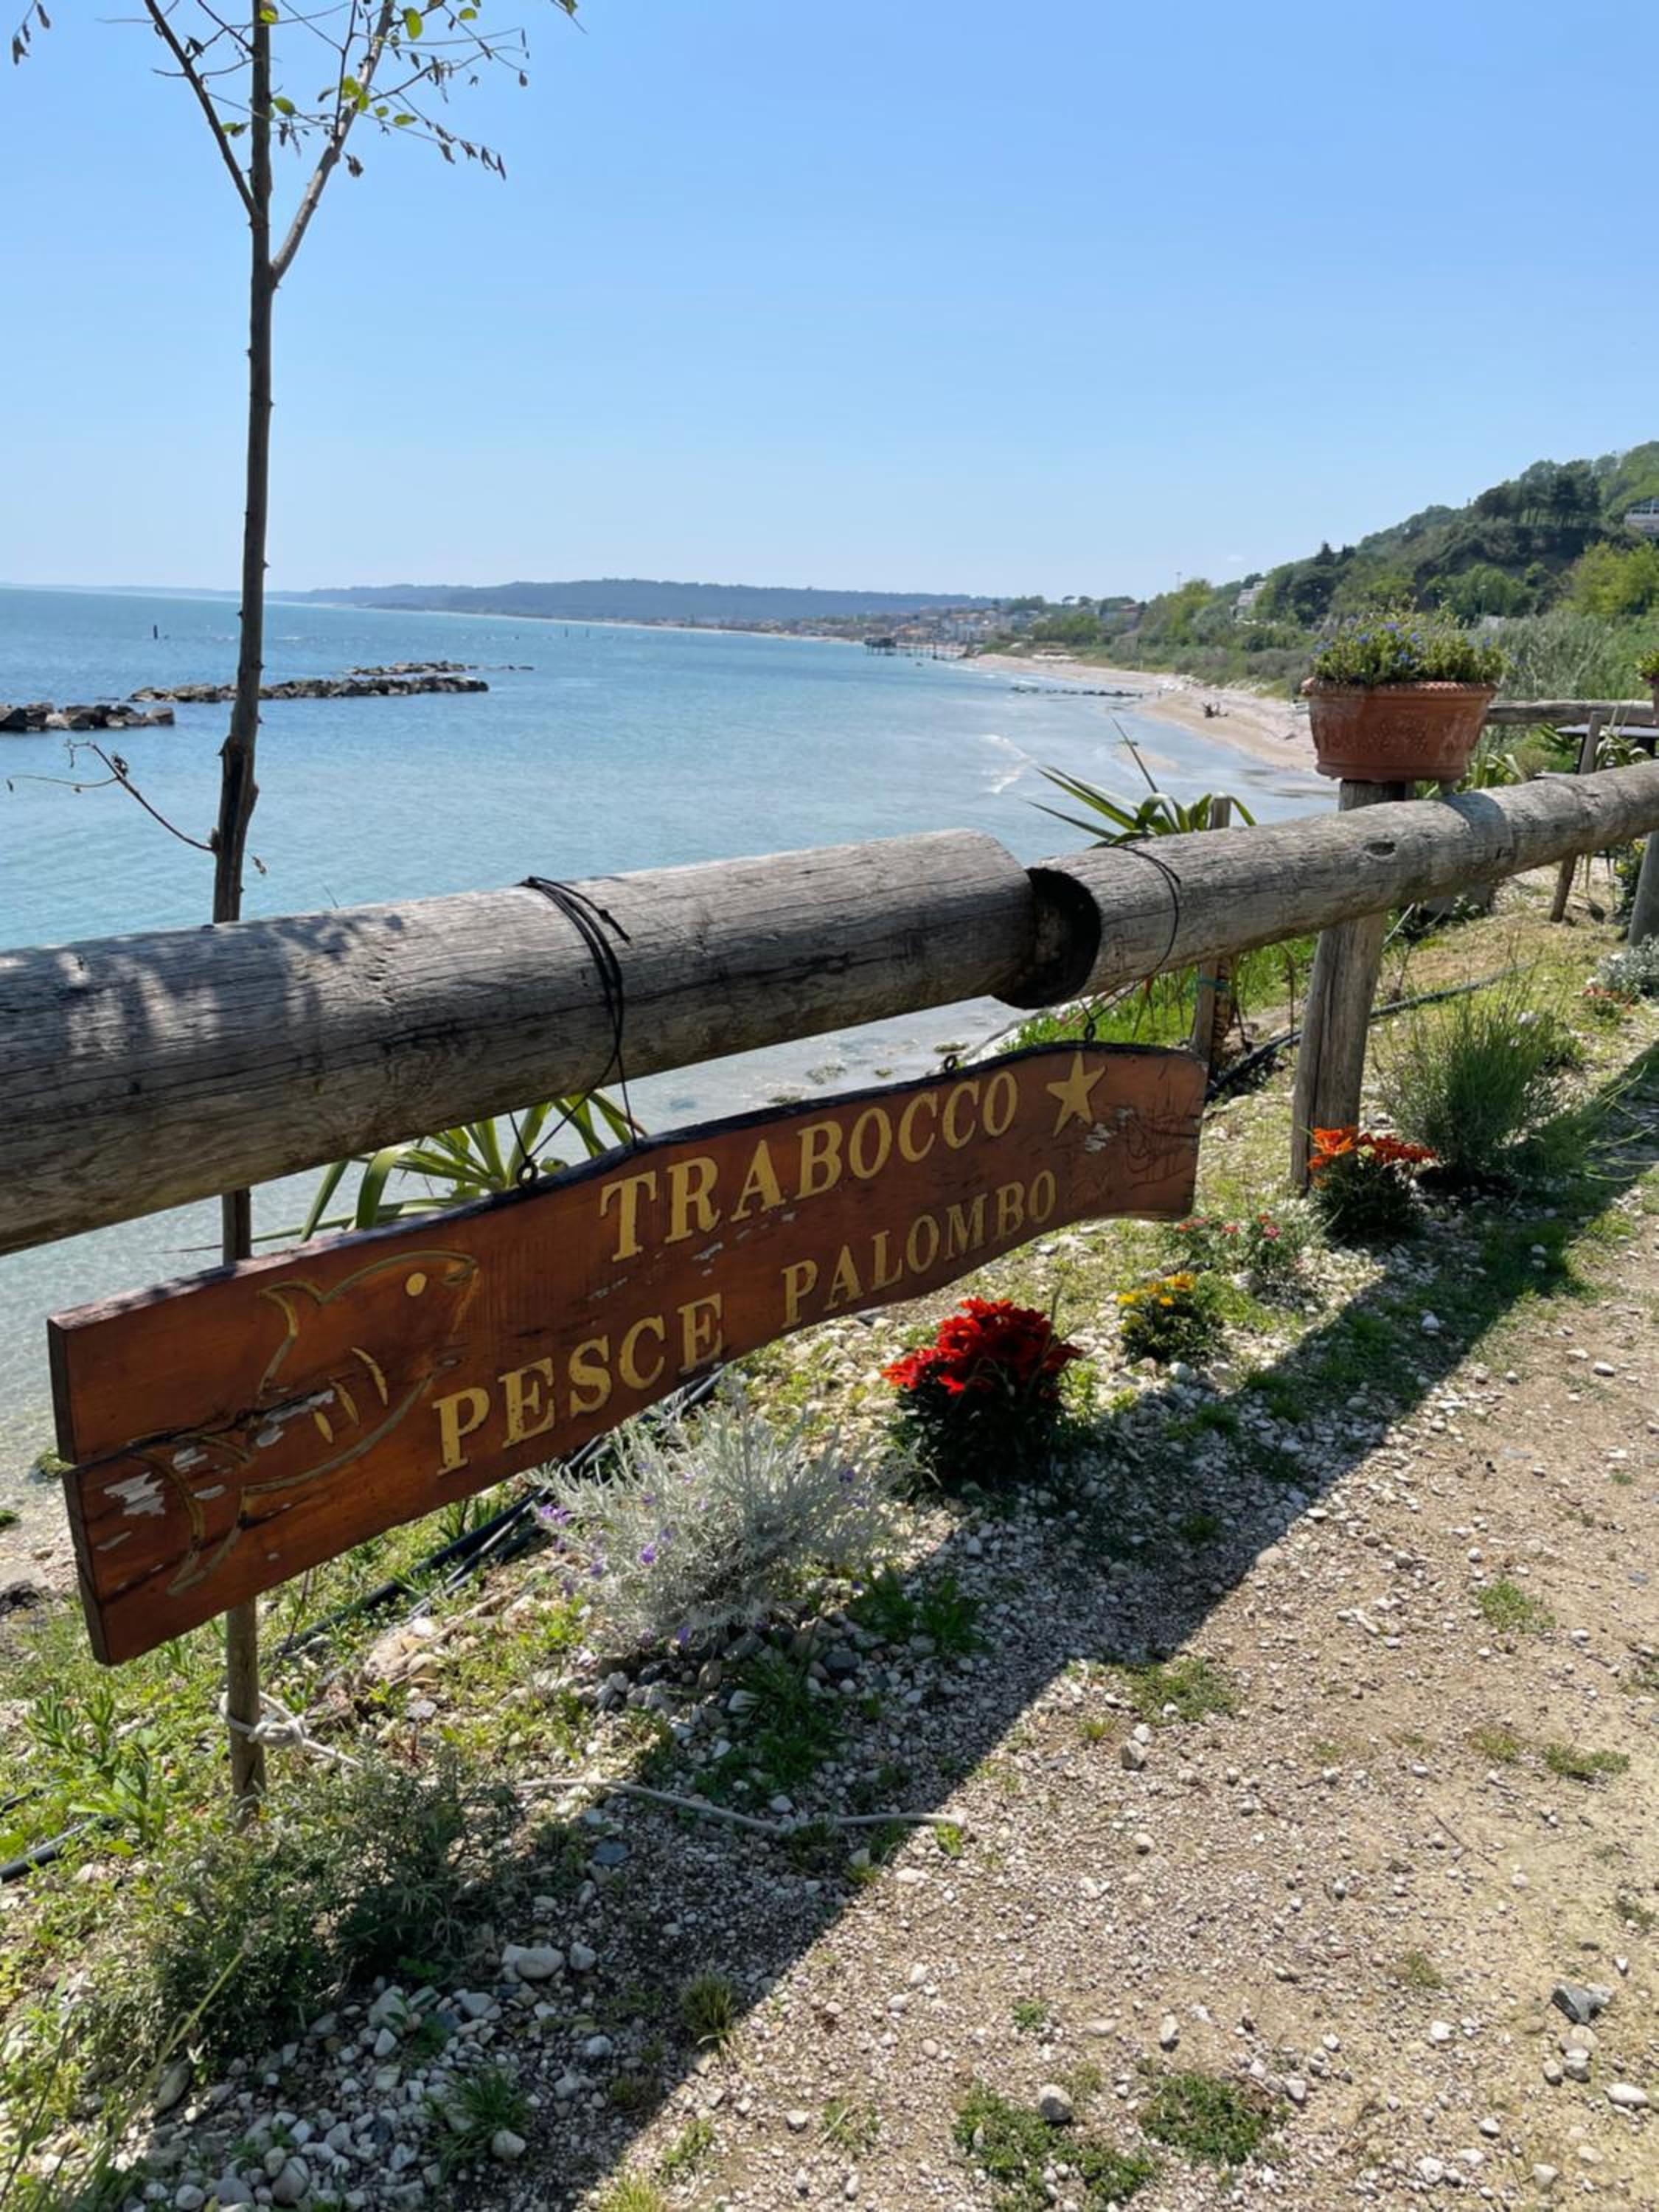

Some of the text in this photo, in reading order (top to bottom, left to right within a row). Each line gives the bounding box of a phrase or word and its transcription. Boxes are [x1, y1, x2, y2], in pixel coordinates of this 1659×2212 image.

[599, 1070, 1019, 1264] TRABOCCO
[431, 1169, 1057, 1477] PESCE PALOMBO
